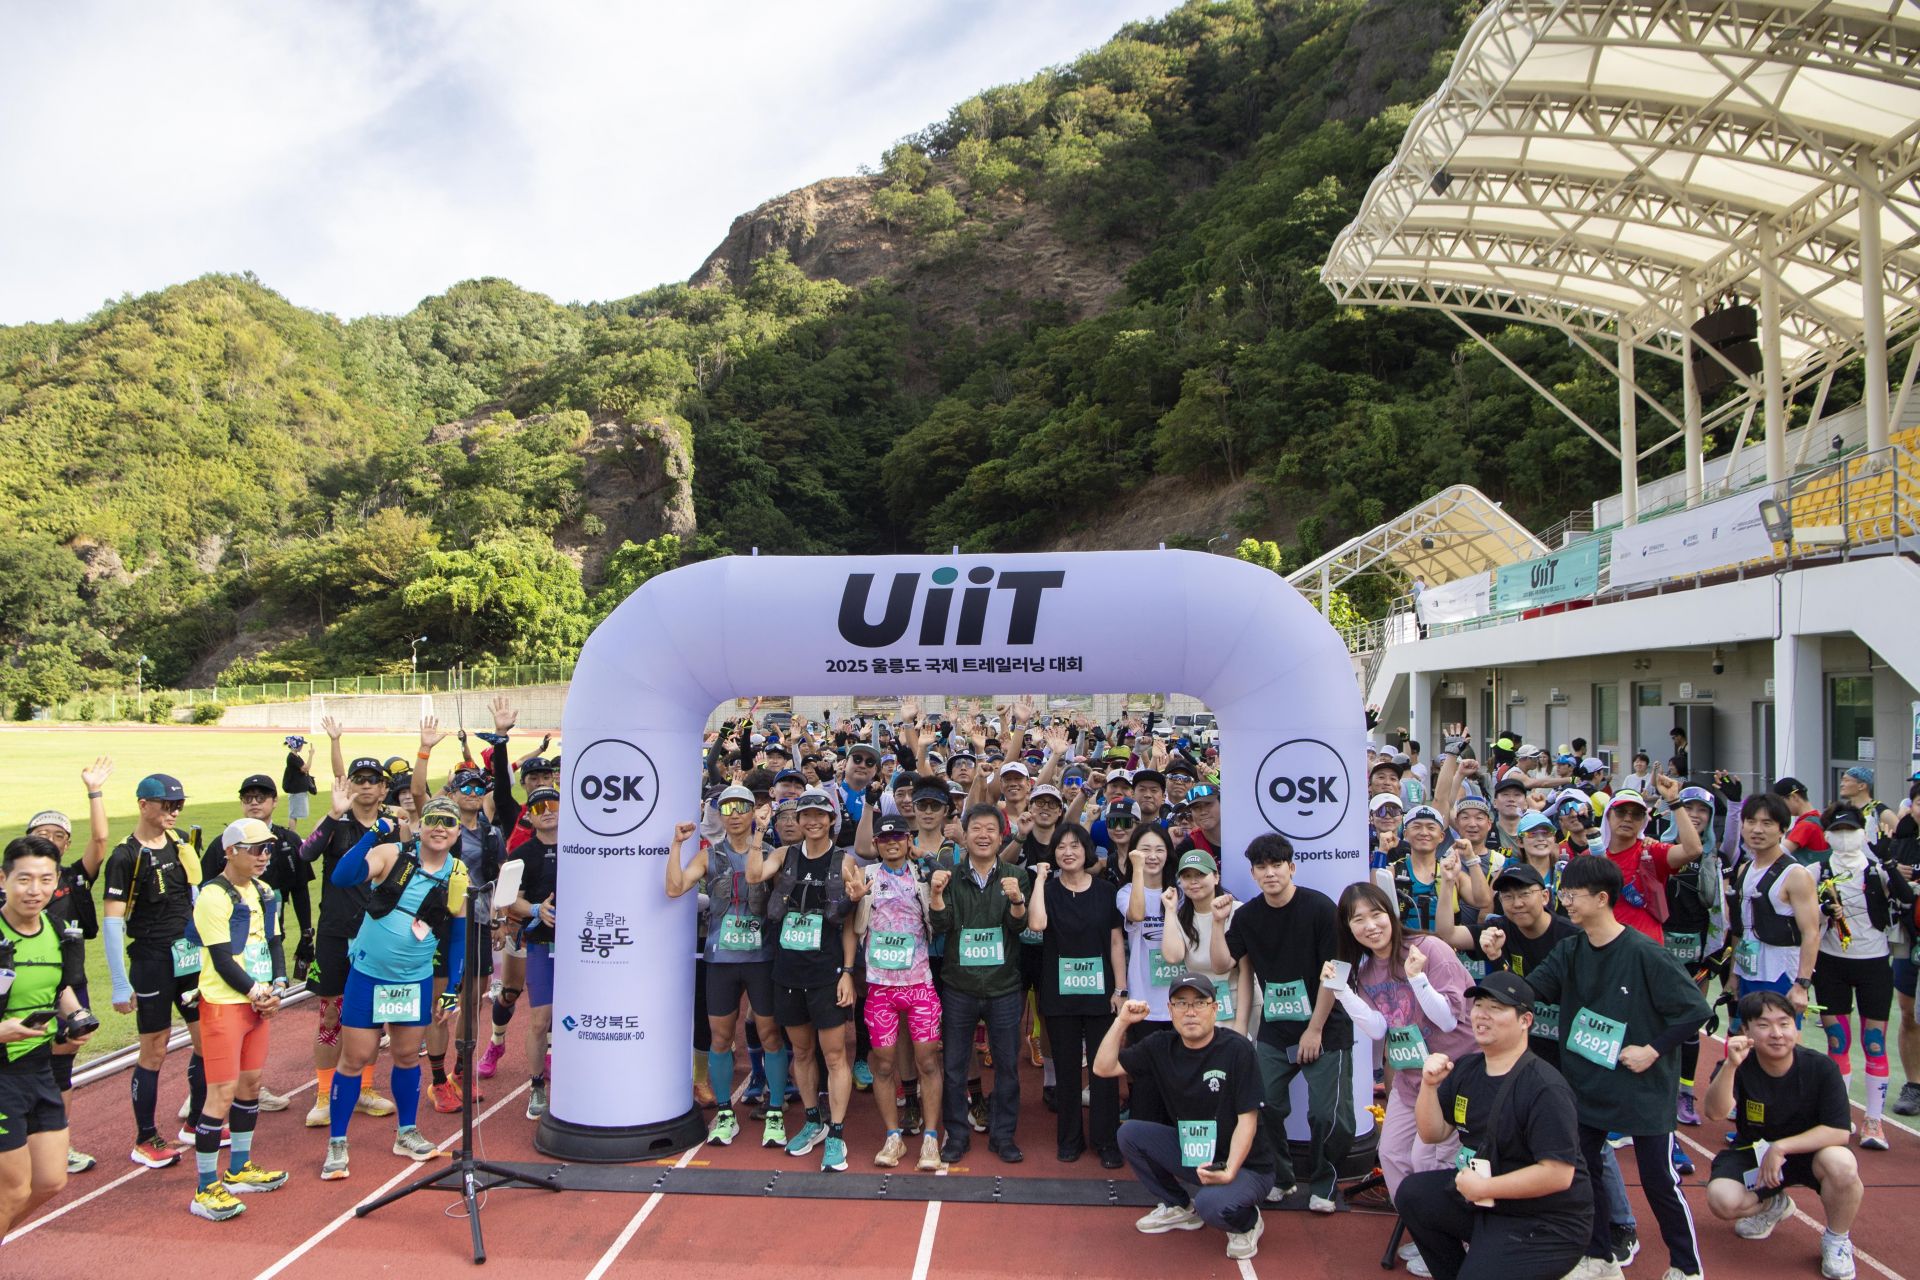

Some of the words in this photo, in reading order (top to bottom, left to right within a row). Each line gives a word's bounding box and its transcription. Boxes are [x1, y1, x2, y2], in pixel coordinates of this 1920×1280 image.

[837, 566, 1066, 648] UiiT
[825, 659, 868, 673] 2025
[871, 658, 922, 673] 울릉도
[924, 658, 958, 673] 국제
[962, 657, 1045, 673] 트레일러닝
[1049, 656, 1083, 672] 대회
[580, 775, 645, 802] OSK
[1269, 776, 1338, 803] OSK
[562, 844, 596, 855] outdoor
[598, 846, 636, 858] sports
[638, 845, 670, 856] korea
[1294, 850, 1333, 863] sports
[1335, 848, 1360, 860] korea
[584, 911, 627, 931] 울루랄라
[578, 927, 634, 959] 울릉도
[723, 930, 755, 944] 4313
[783, 929, 812, 943] 4301
[872, 948, 906, 962] 4302
[964, 946, 995, 959] 4001
[1063, 975, 1097, 988] 4003
[378, 1002, 412, 1015] 4064
[1268, 1001, 1303, 1014] 4293
[579, 1014, 639, 1029] 경상북도
[578, 1030, 645, 1041] GYEONGSANGBUK-DO
[1573, 1029, 1610, 1057] 4292
[1183, 1142, 1211, 1158] 4007
